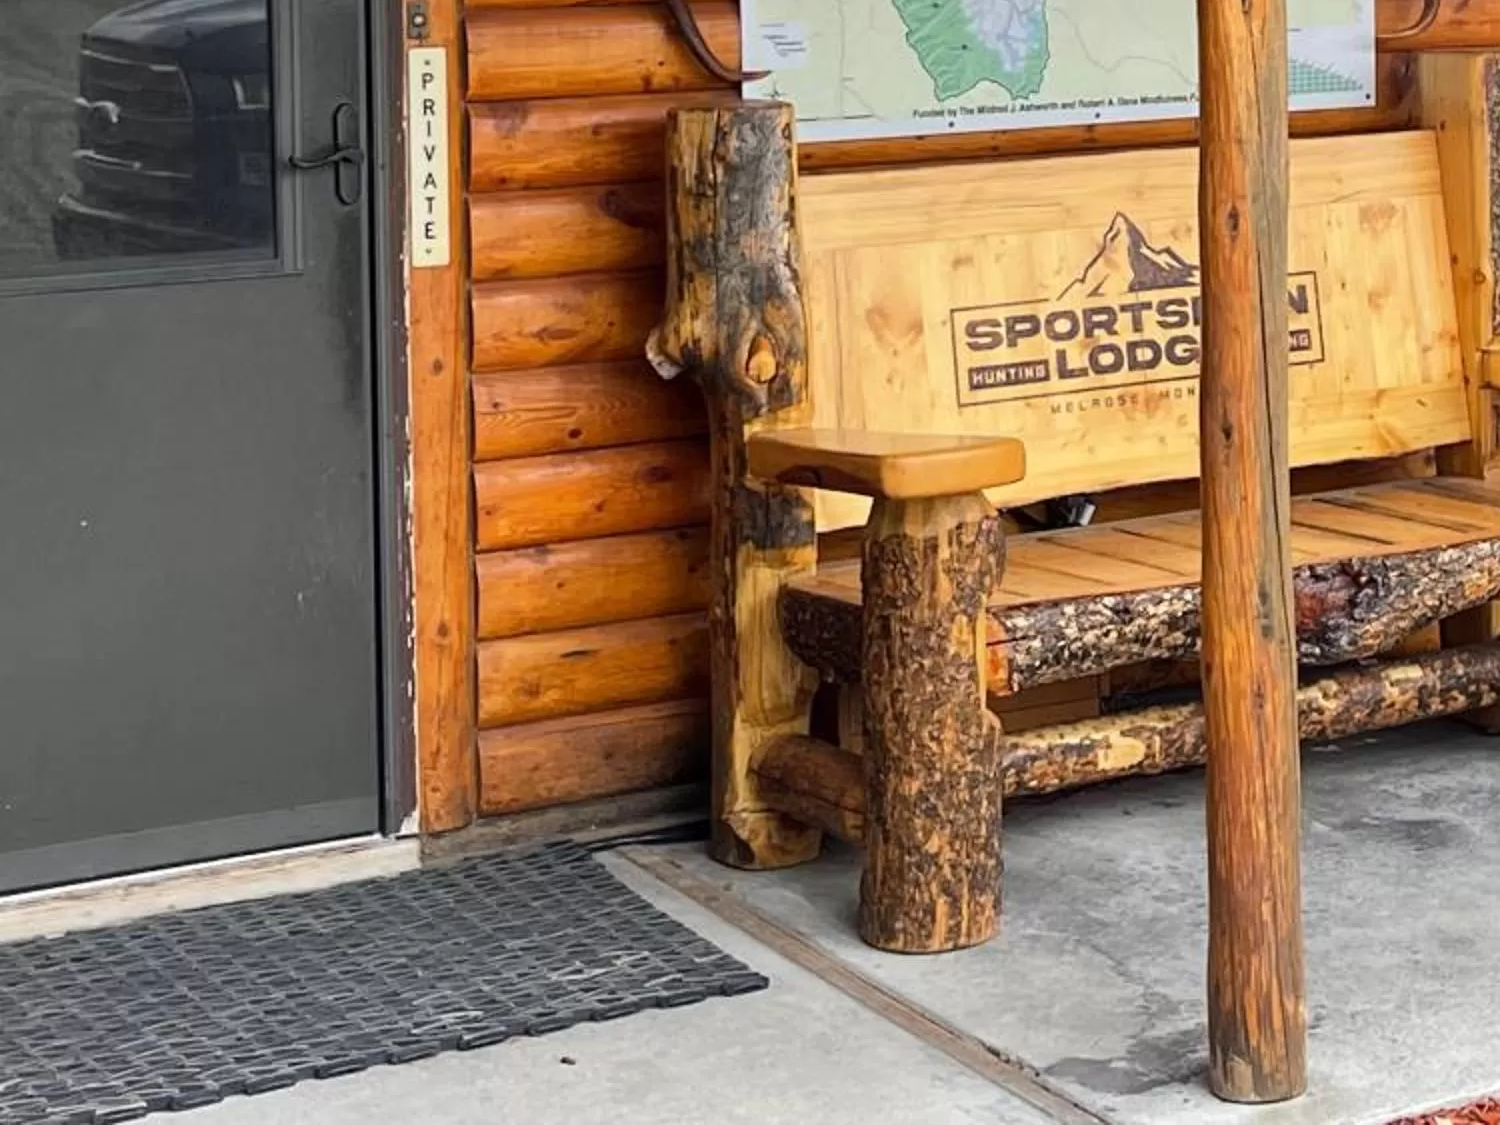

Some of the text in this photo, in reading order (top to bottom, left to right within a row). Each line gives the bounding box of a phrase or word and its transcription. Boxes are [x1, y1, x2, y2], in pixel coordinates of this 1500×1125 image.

[421, 72, 437, 240] PRIVATE
[964, 285, 1309, 352] SPORTSN
[971, 334, 1201, 386] HUNTING LODG
[1050, 392, 1140, 414] MELROSE
